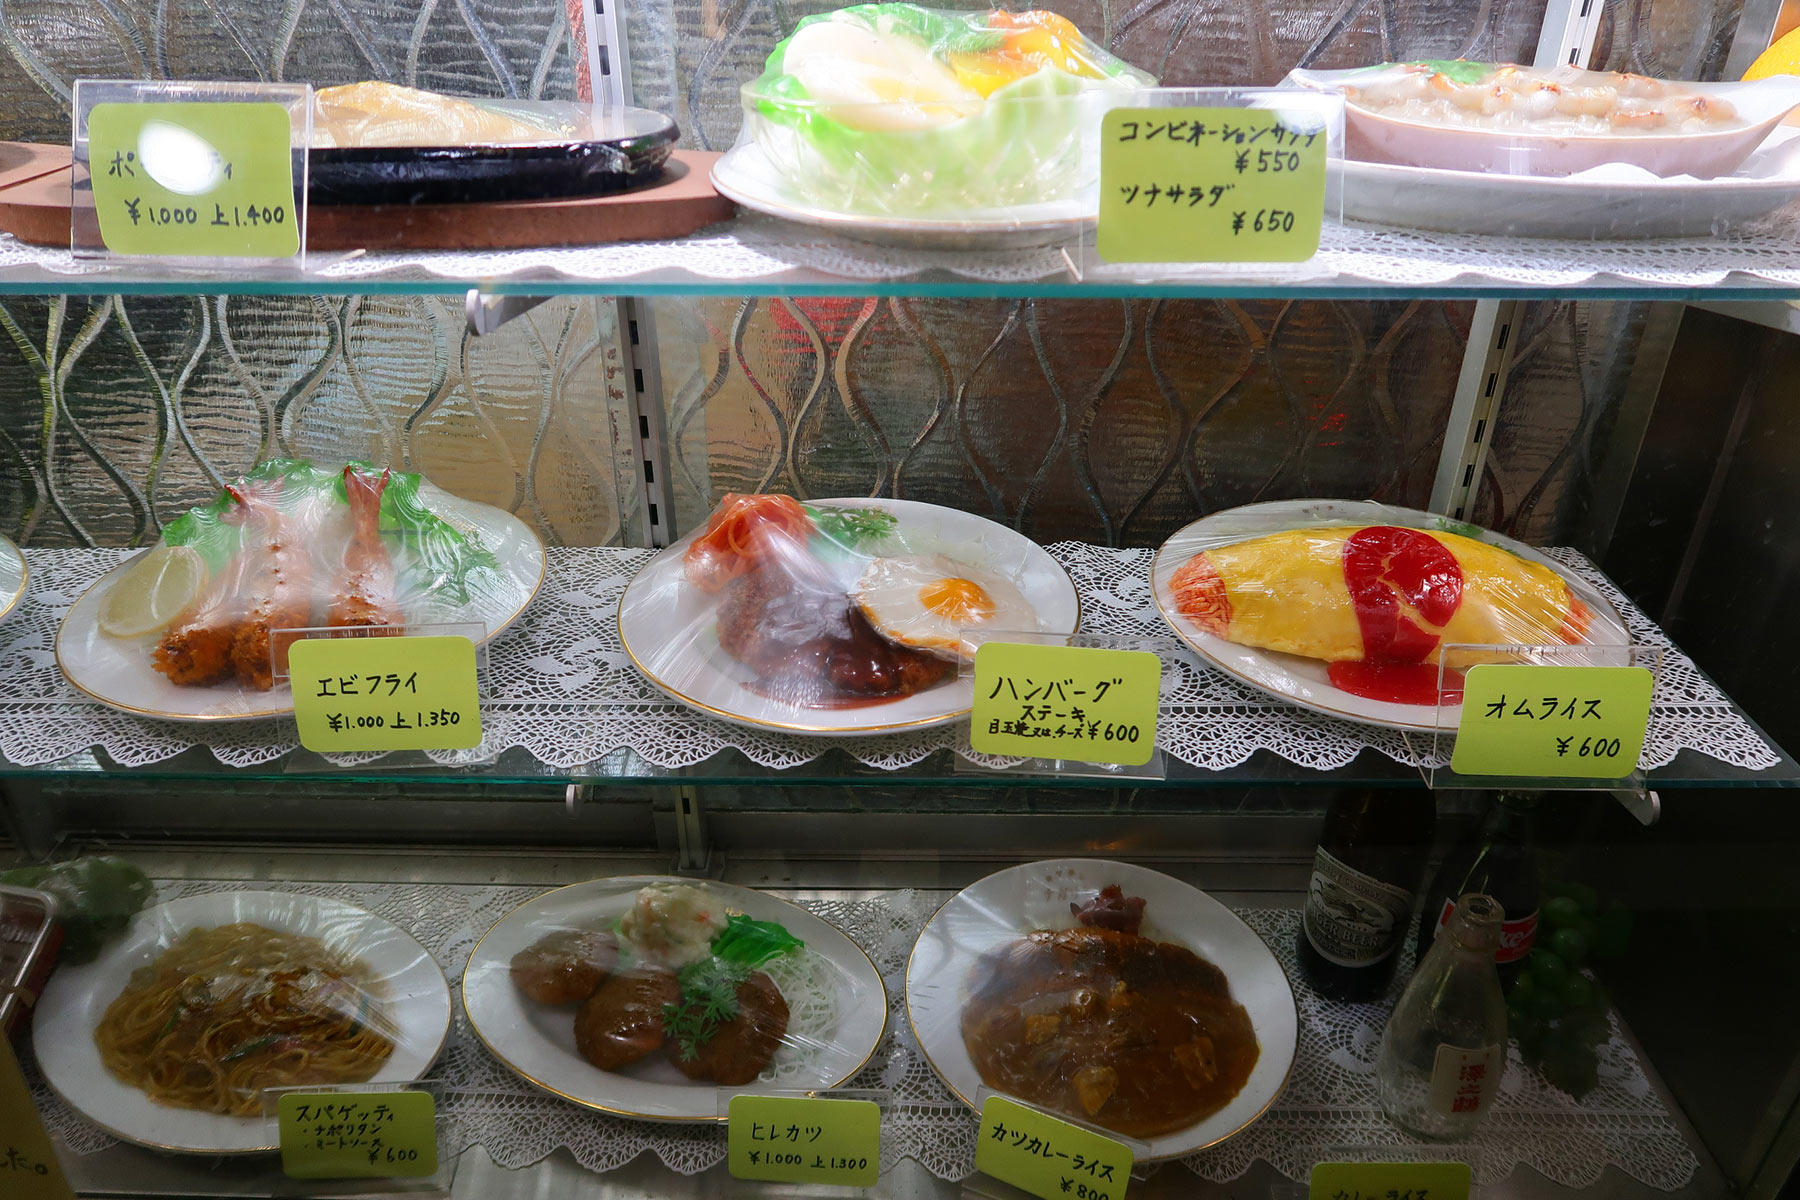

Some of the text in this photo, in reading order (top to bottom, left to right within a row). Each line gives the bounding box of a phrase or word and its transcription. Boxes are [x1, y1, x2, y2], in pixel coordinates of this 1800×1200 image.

[1119, 120, 1317, 147] コンビネーションサ
[1234, 149, 1300, 174] ¥550
[1120, 183, 1236, 207] ツナサラダ
[1231, 209, 1294, 235] ¥650
[316, 671, 418, 697] エビフライ
[988, 676, 1124, 703] ハンバーグ
[1020, 704, 1087, 723] ステーキ
[1484, 694, 1603, 721] オムライス
[1087, 719, 1140, 744] ¥600
[1556, 735, 1622, 758] ¥600
[751, 1121, 823, 1143] ヒレカツ
[991, 1122, 1116, 1184] カツカレーライス
